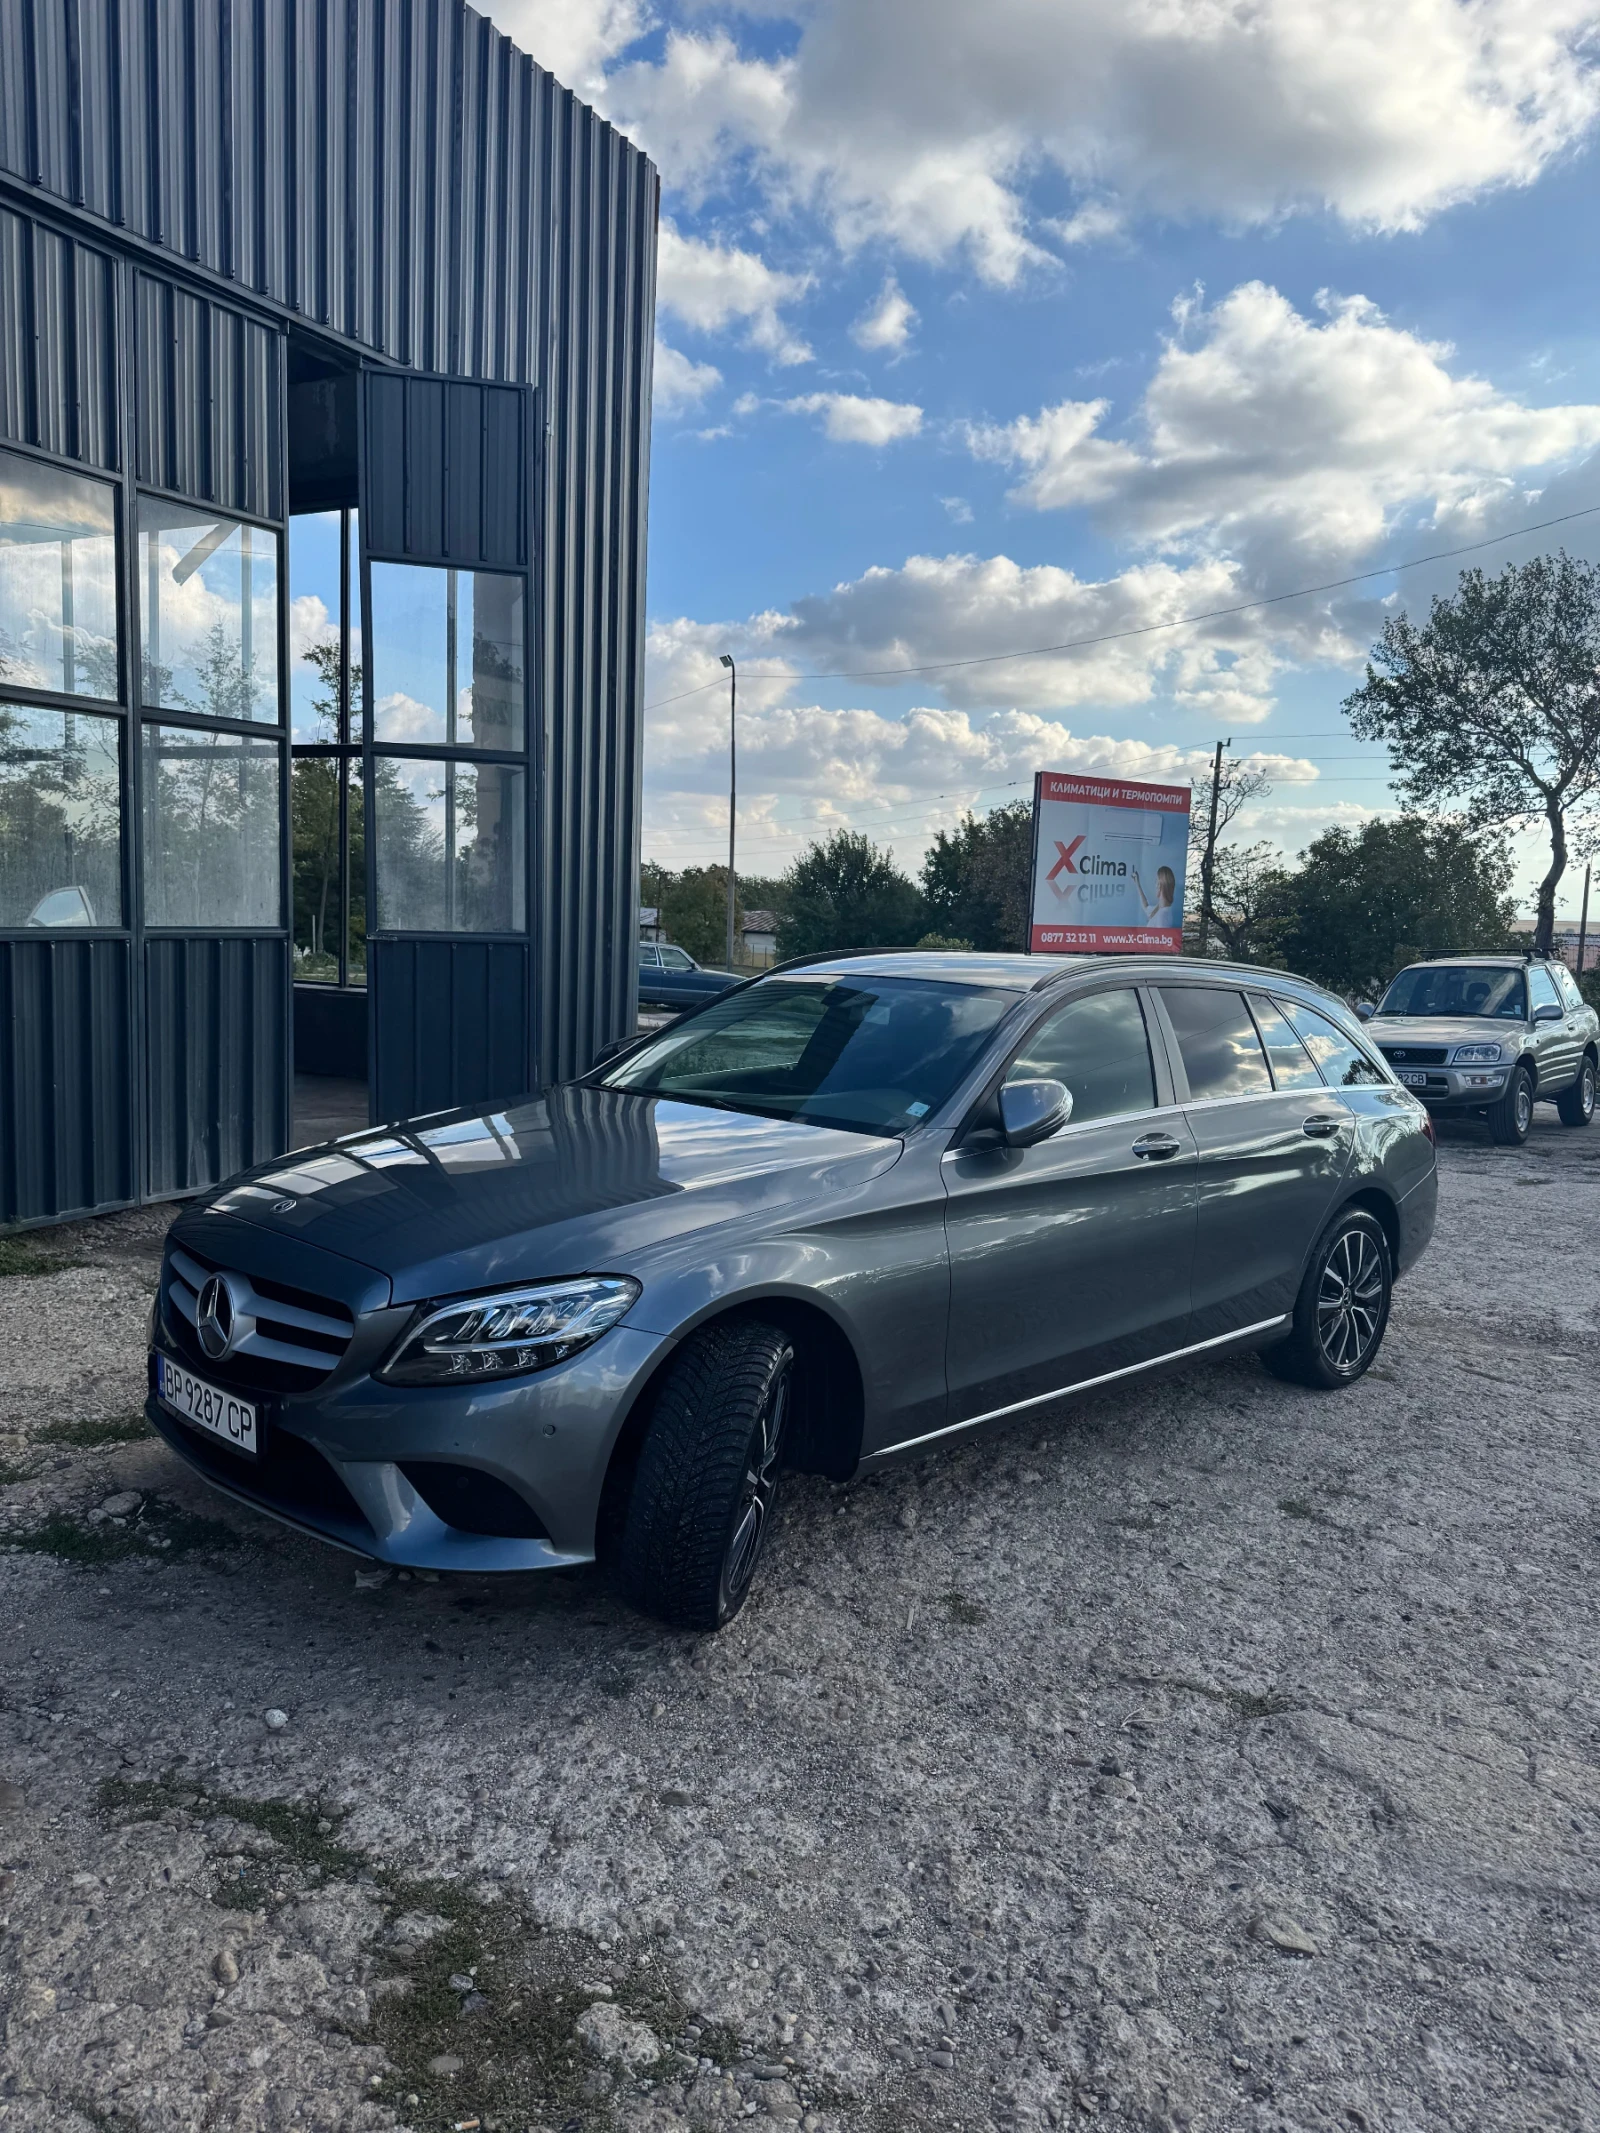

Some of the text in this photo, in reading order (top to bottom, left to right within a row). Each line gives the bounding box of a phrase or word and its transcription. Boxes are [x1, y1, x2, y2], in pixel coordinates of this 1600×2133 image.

[1050, 781, 1182, 805] КЛИМАТИЦИ И ТЕРМОПОМПИ
[1041, 932, 1173, 946] 0877 32 12 11 www.X-Clima.bg
[1411, 1074, 1425, 1084] CB
[166, 1363, 252, 1441] BP 9287 CP
